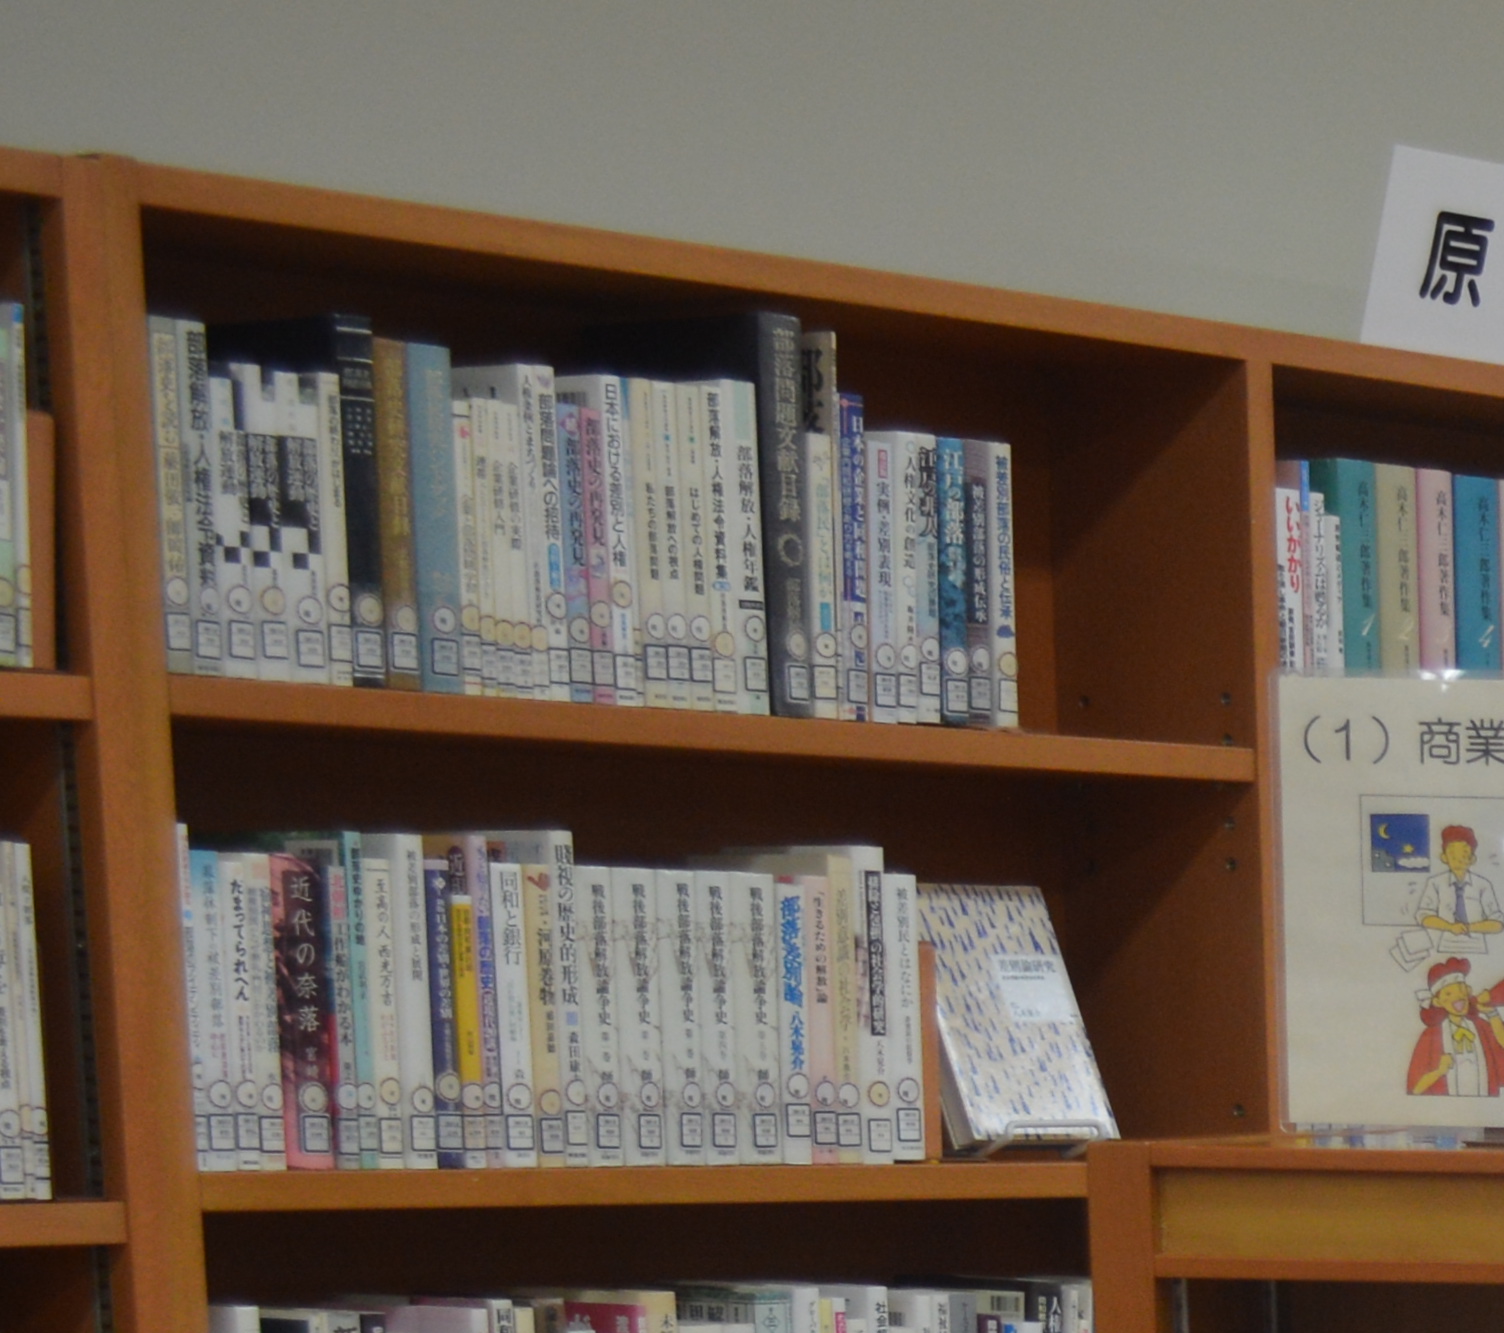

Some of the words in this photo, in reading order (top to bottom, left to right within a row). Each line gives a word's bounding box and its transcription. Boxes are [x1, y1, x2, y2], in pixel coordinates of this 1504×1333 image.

[288, 874, 322, 1035] 近代の奈落
[500, 870, 523, 966] 同和と銀行
